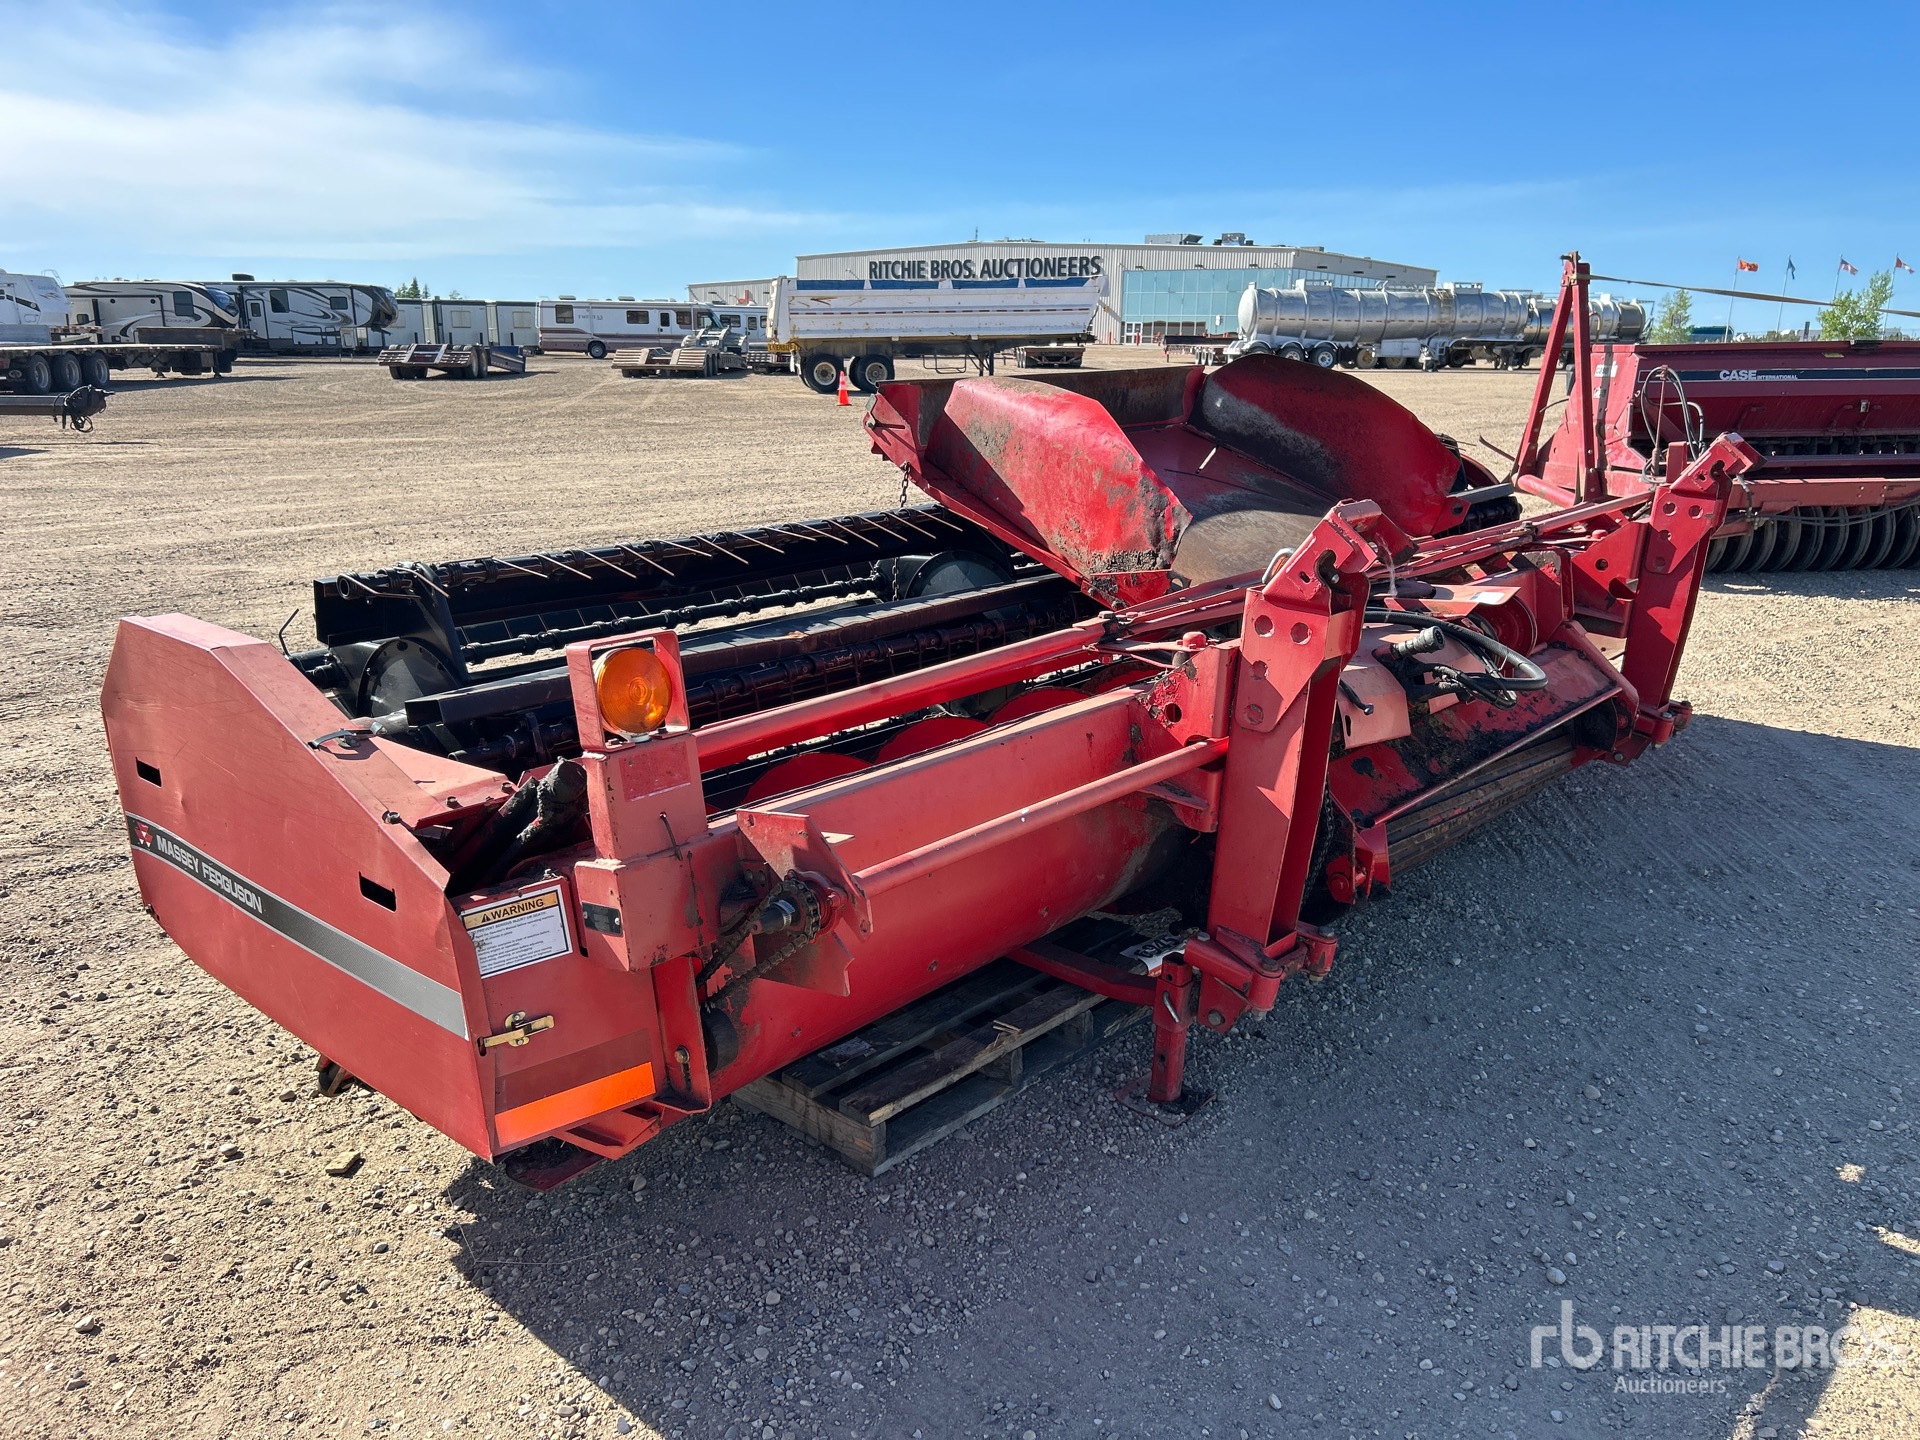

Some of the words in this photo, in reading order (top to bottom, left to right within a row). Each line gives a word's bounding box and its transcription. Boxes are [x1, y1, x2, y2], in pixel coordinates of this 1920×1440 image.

[869, 260, 926, 279] RITCHIE
[931, 260, 975, 278] BROS.
[980, 256, 1100, 278] AUCTIONEERS
[1720, 370, 1756, 380] CASE
[156, 835, 200, 873] MASSEY
[202, 863, 262, 914] FERGUSON
[490, 898, 544, 920] WARNING
